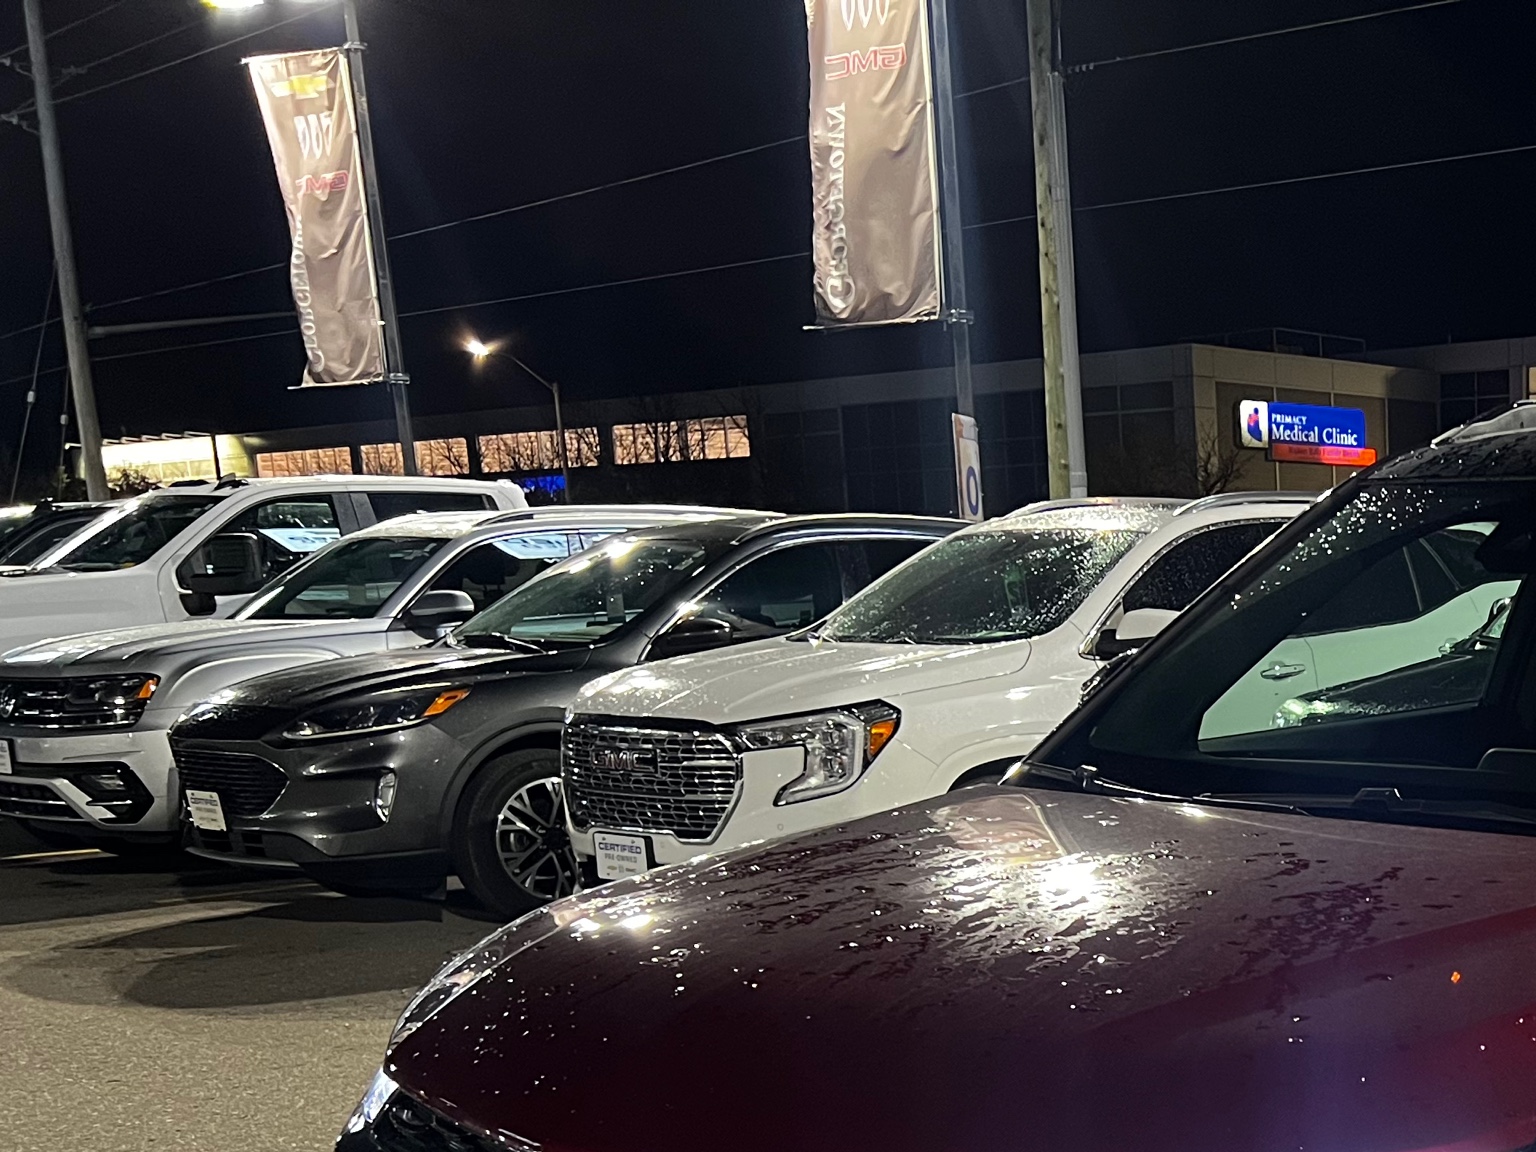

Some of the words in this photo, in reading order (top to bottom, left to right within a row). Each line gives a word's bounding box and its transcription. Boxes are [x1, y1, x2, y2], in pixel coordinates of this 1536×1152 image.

[1271, 413, 1307, 425] PRIMACY
[1271, 424, 1319, 443] Medical
[1322, 428, 1358, 446] Clinic
[591, 750, 656, 774] GMC
[598, 842, 642, 855] CERTIFIED
